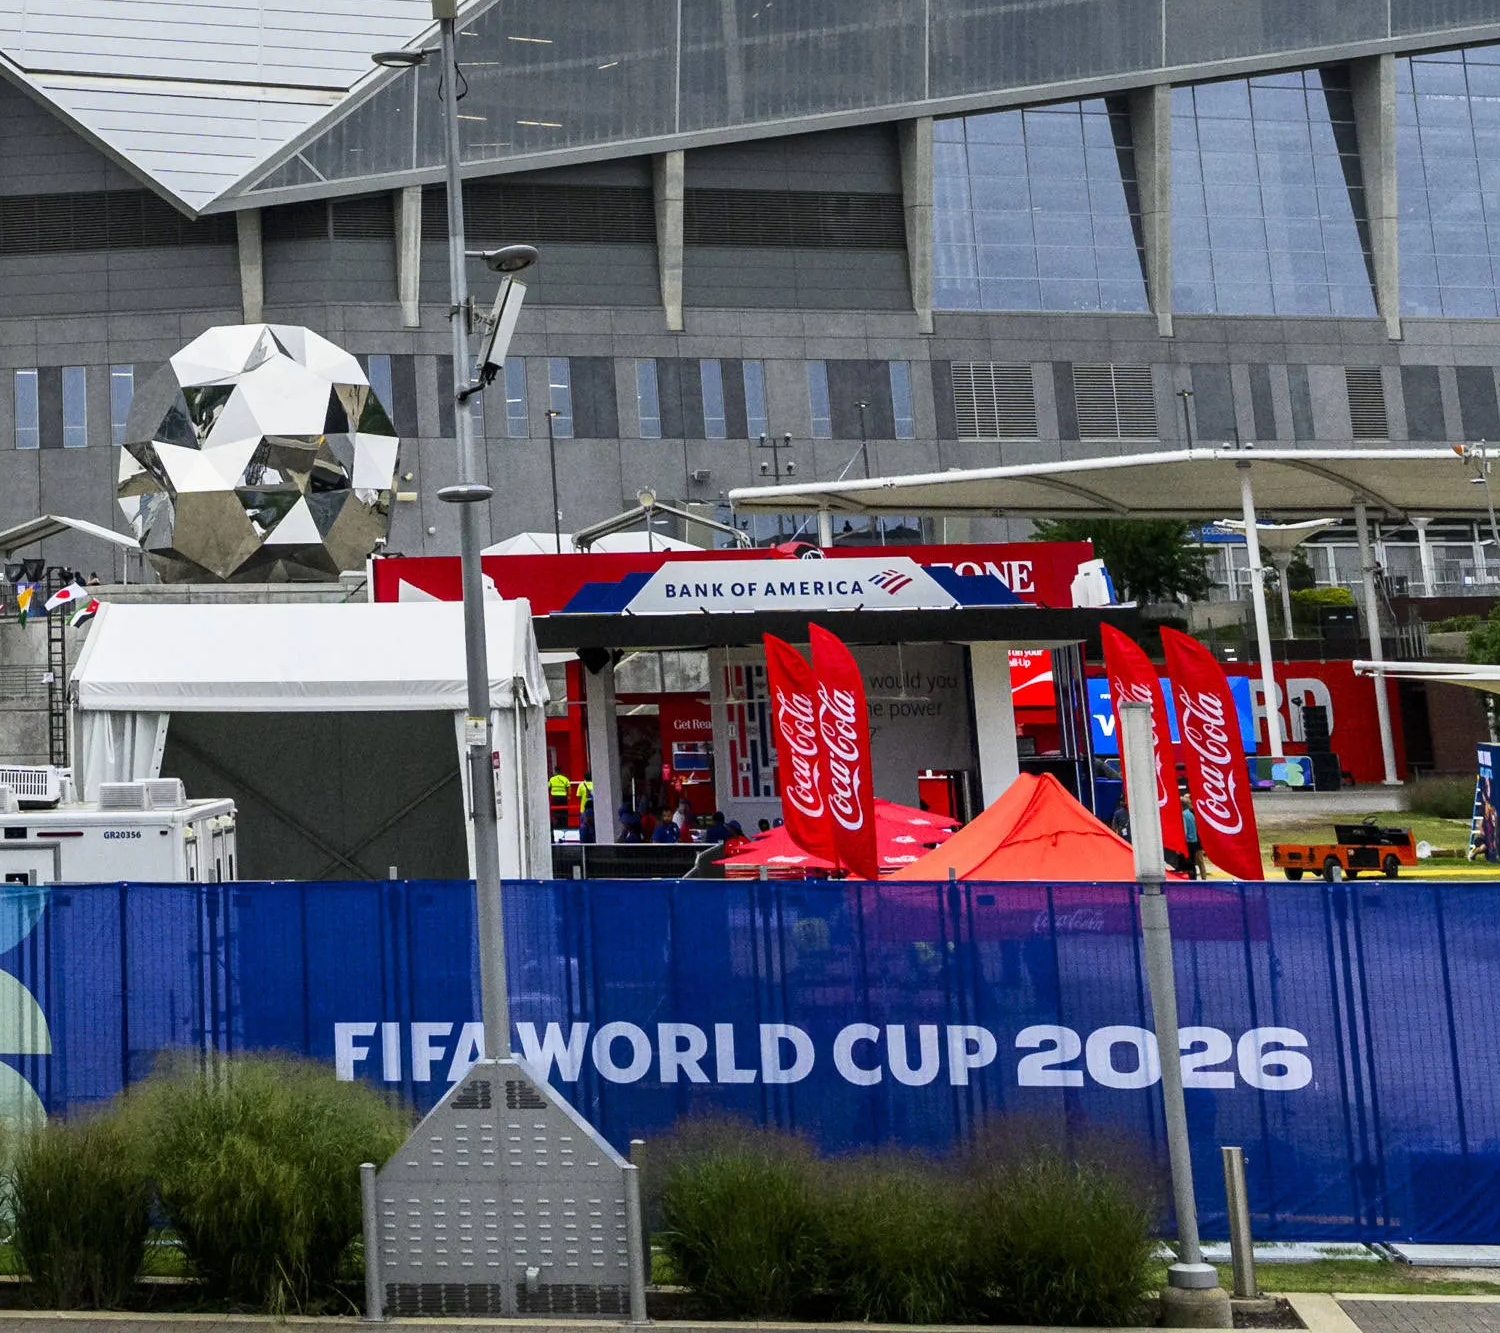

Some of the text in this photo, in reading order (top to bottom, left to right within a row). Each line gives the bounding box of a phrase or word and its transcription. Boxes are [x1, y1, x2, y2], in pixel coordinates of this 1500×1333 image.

[665, 580, 864, 599] BANK OF AMERICA
[869, 672, 957, 693] would you
[890, 702, 942, 721] power
[673, 719, 691, 730] Get
[776, 685, 825, 818] Coca-Cola
[817, 681, 864, 831] Coca-Cola
[1179, 686, 1244, 835] Coca-Cola
[104, 831, 141, 839] GR20356
[334, 1021, 1314, 1091] FIFA WORLD CUP 2026
